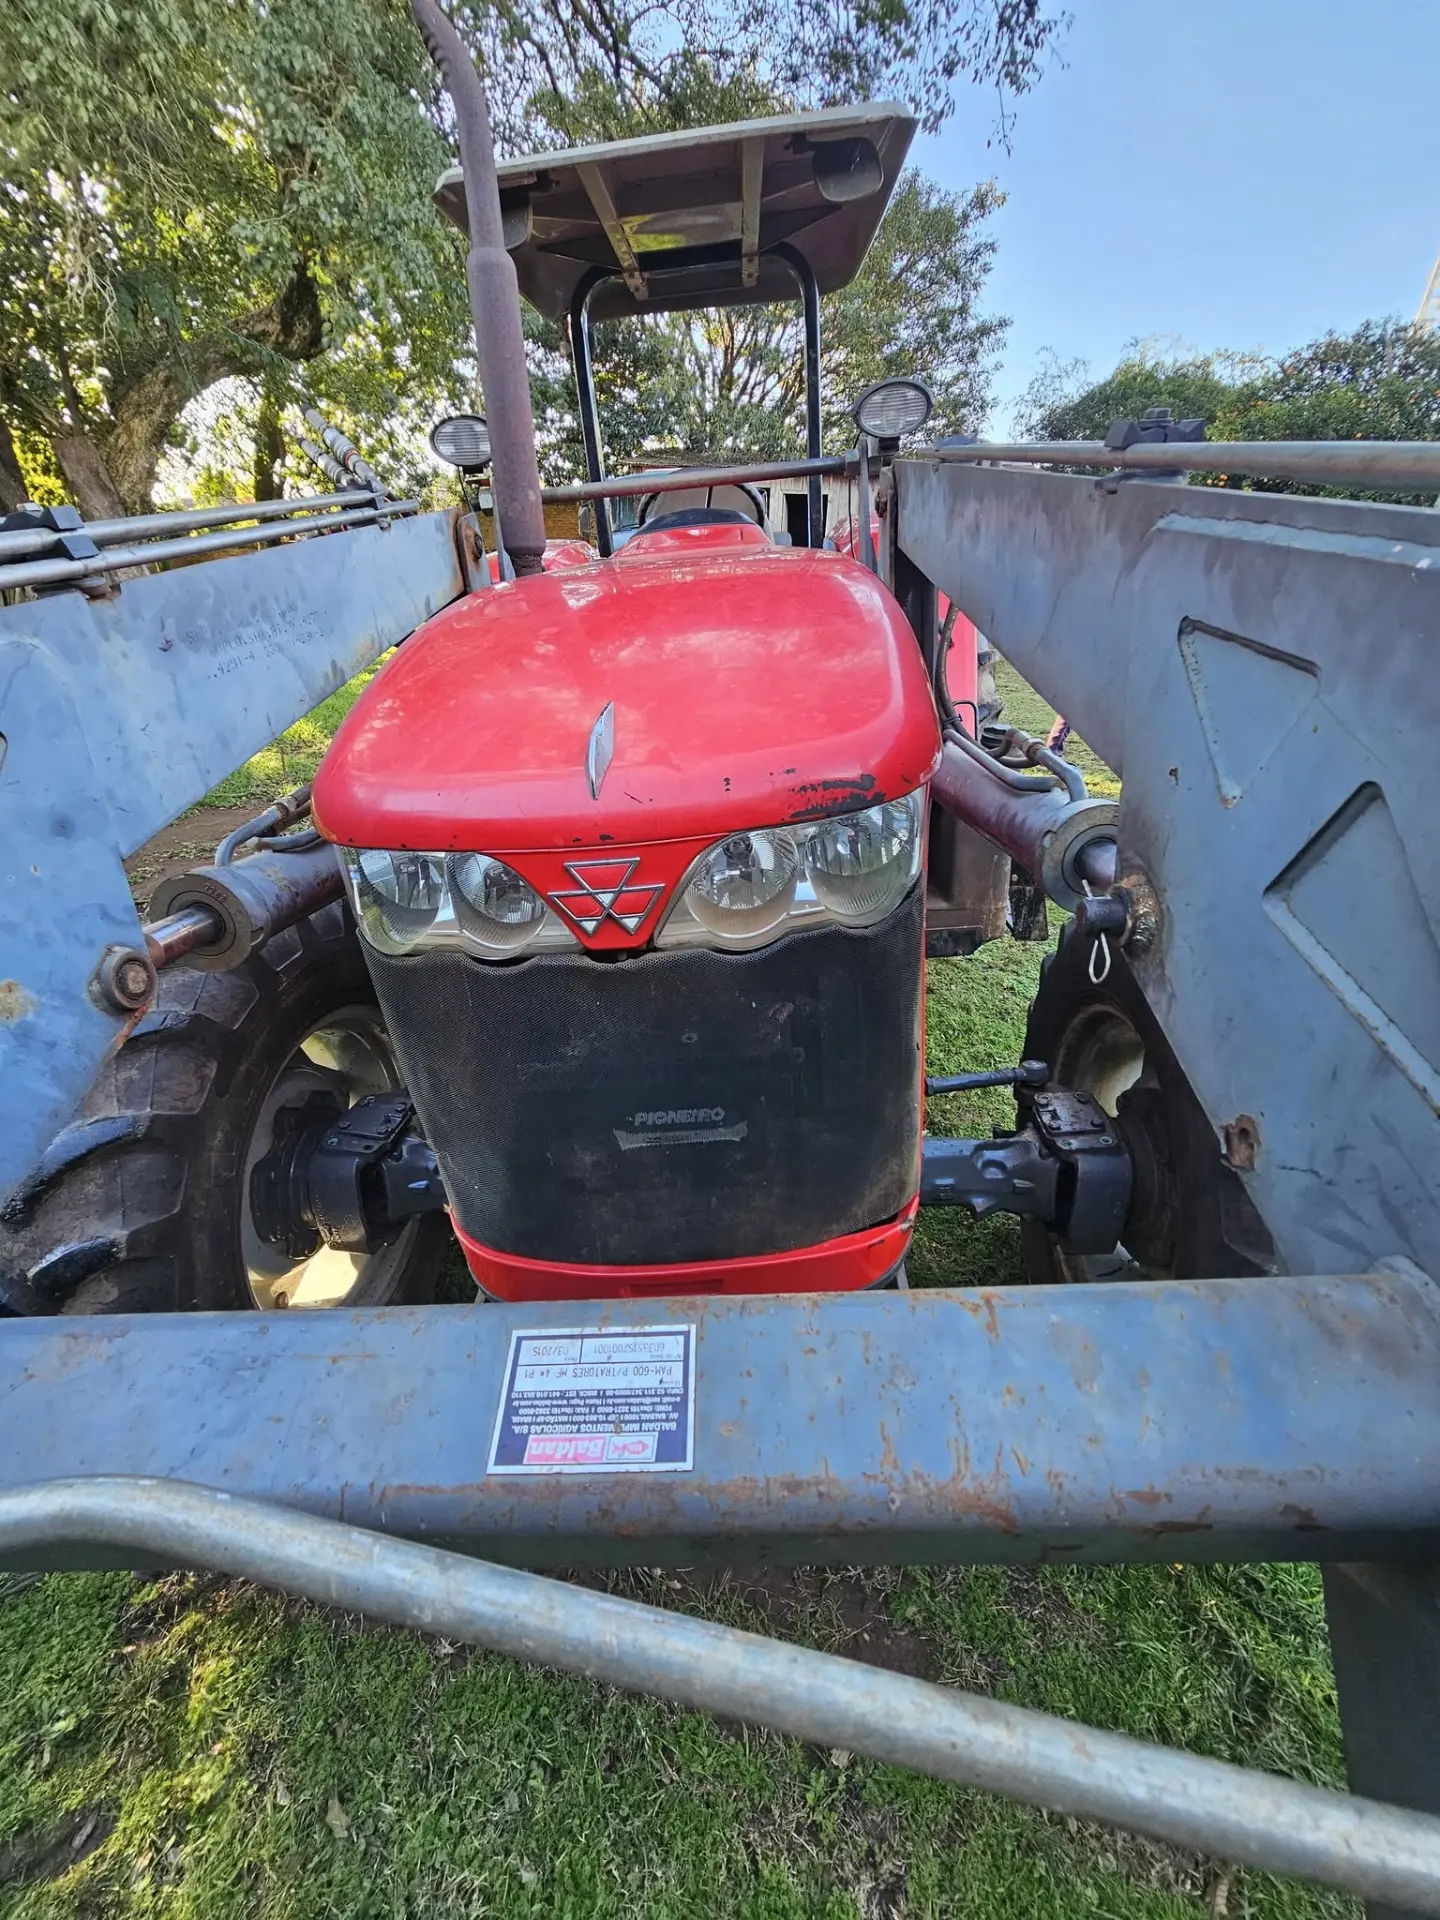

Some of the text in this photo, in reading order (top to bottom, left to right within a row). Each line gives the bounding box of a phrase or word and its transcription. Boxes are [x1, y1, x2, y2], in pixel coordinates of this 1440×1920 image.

[573, 1367, 628, 1377] P/TRATORES
[633, 1365, 672, 1376] PAM-600
[512, 1422, 677, 1434] BALDAN IMPLMENTOS AGRÍCOLAS S/A.
[531, 1439, 604, 1459] Baldan
